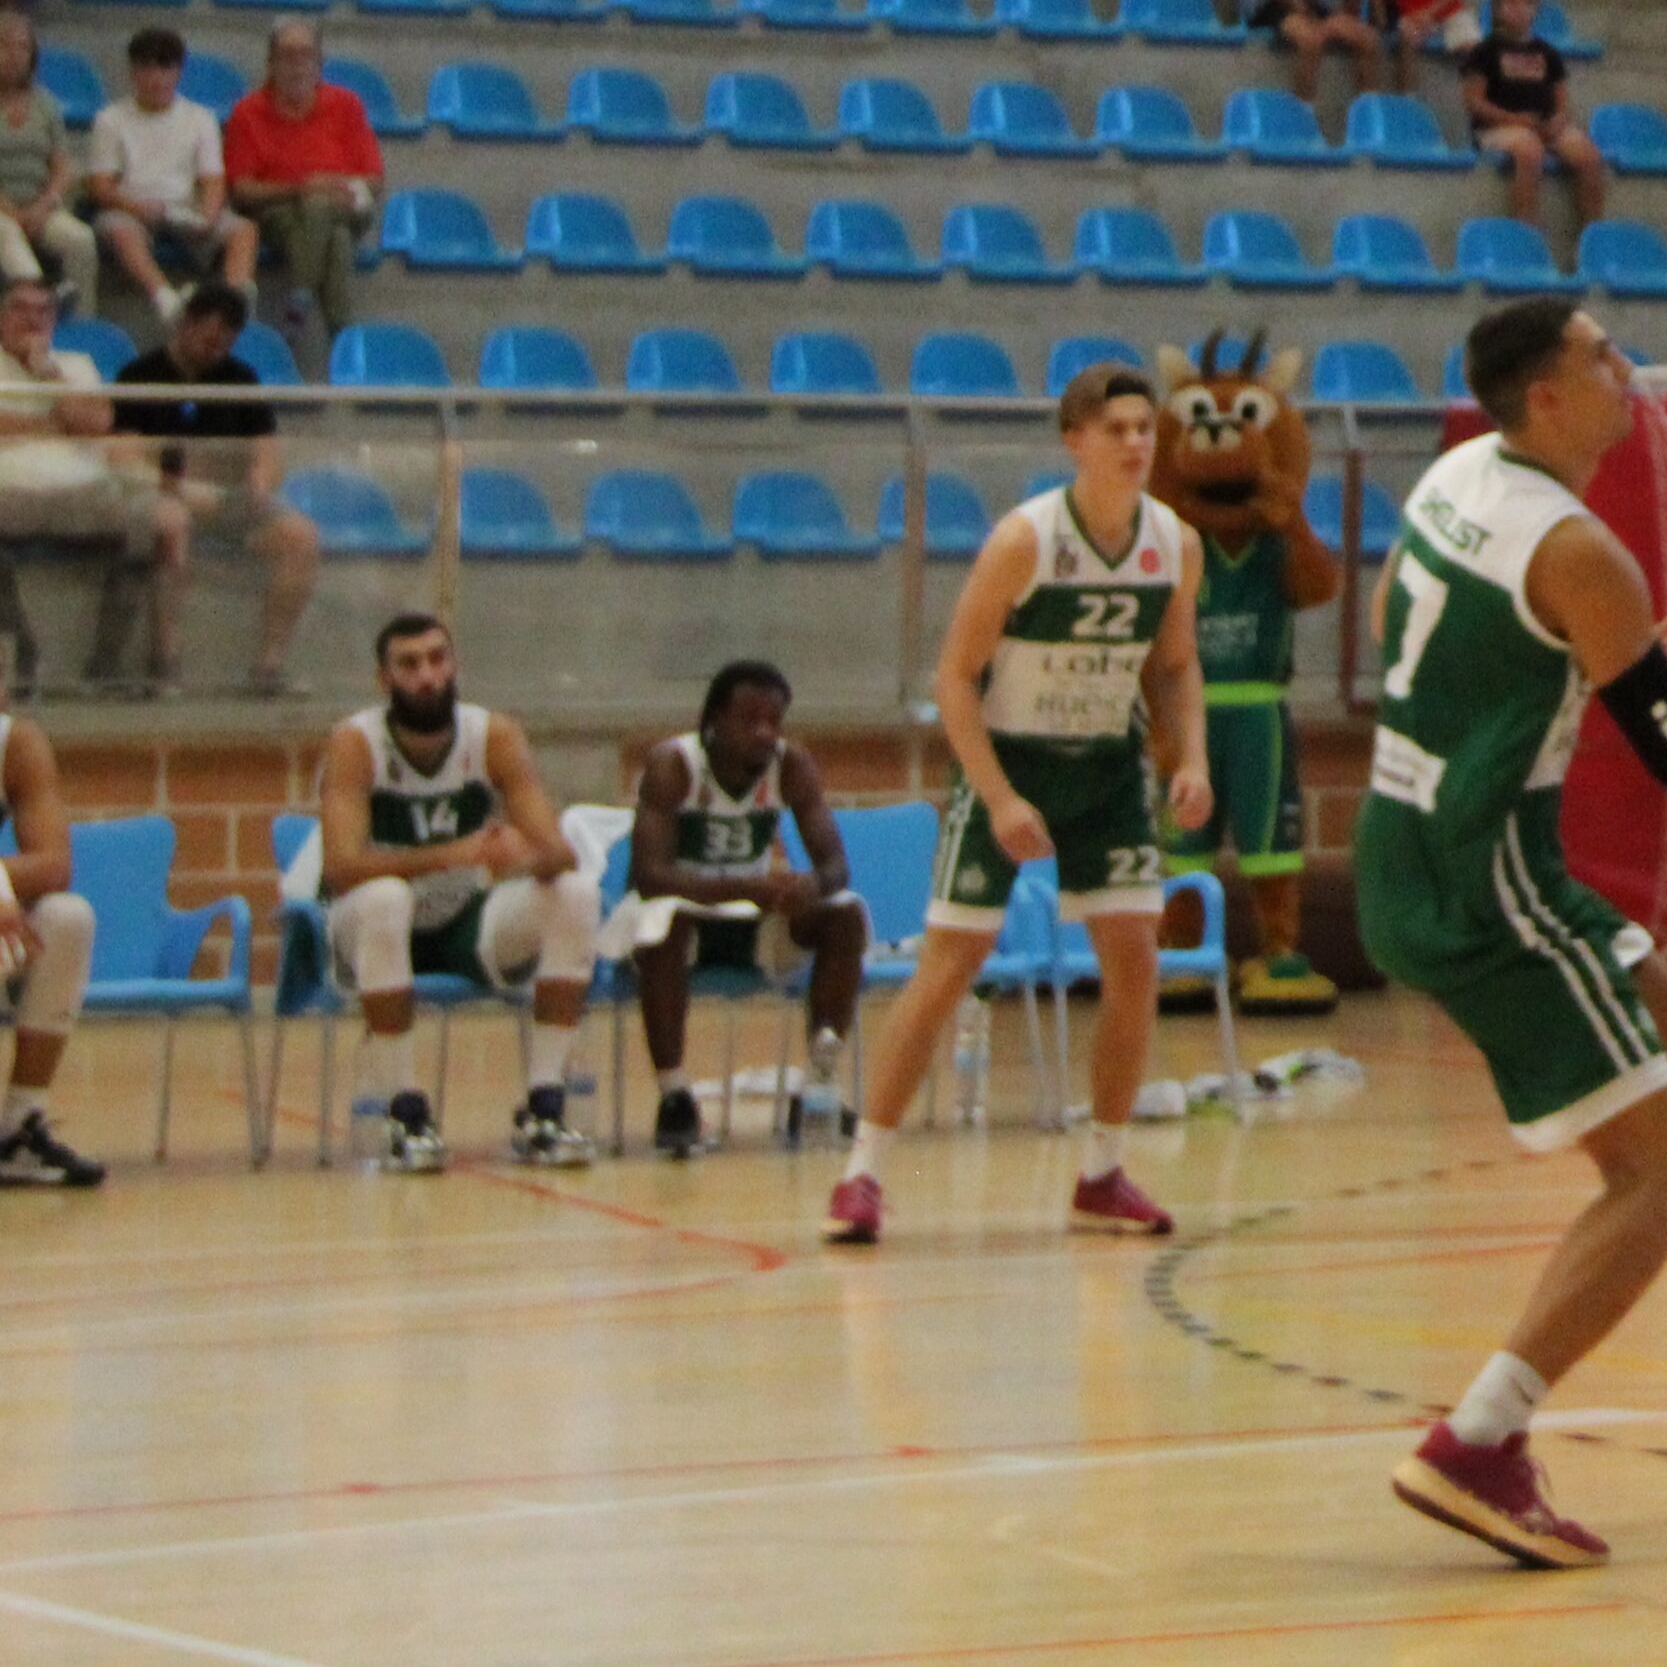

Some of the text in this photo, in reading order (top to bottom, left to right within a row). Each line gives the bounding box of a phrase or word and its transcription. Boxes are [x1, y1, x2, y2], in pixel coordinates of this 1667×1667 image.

[1071, 593, 1140, 638] 22
[1384, 551, 1448, 701] 7
[411, 800, 460, 841] 14
[703, 818, 754, 860] 33
[1107, 844, 1160, 882] 22
